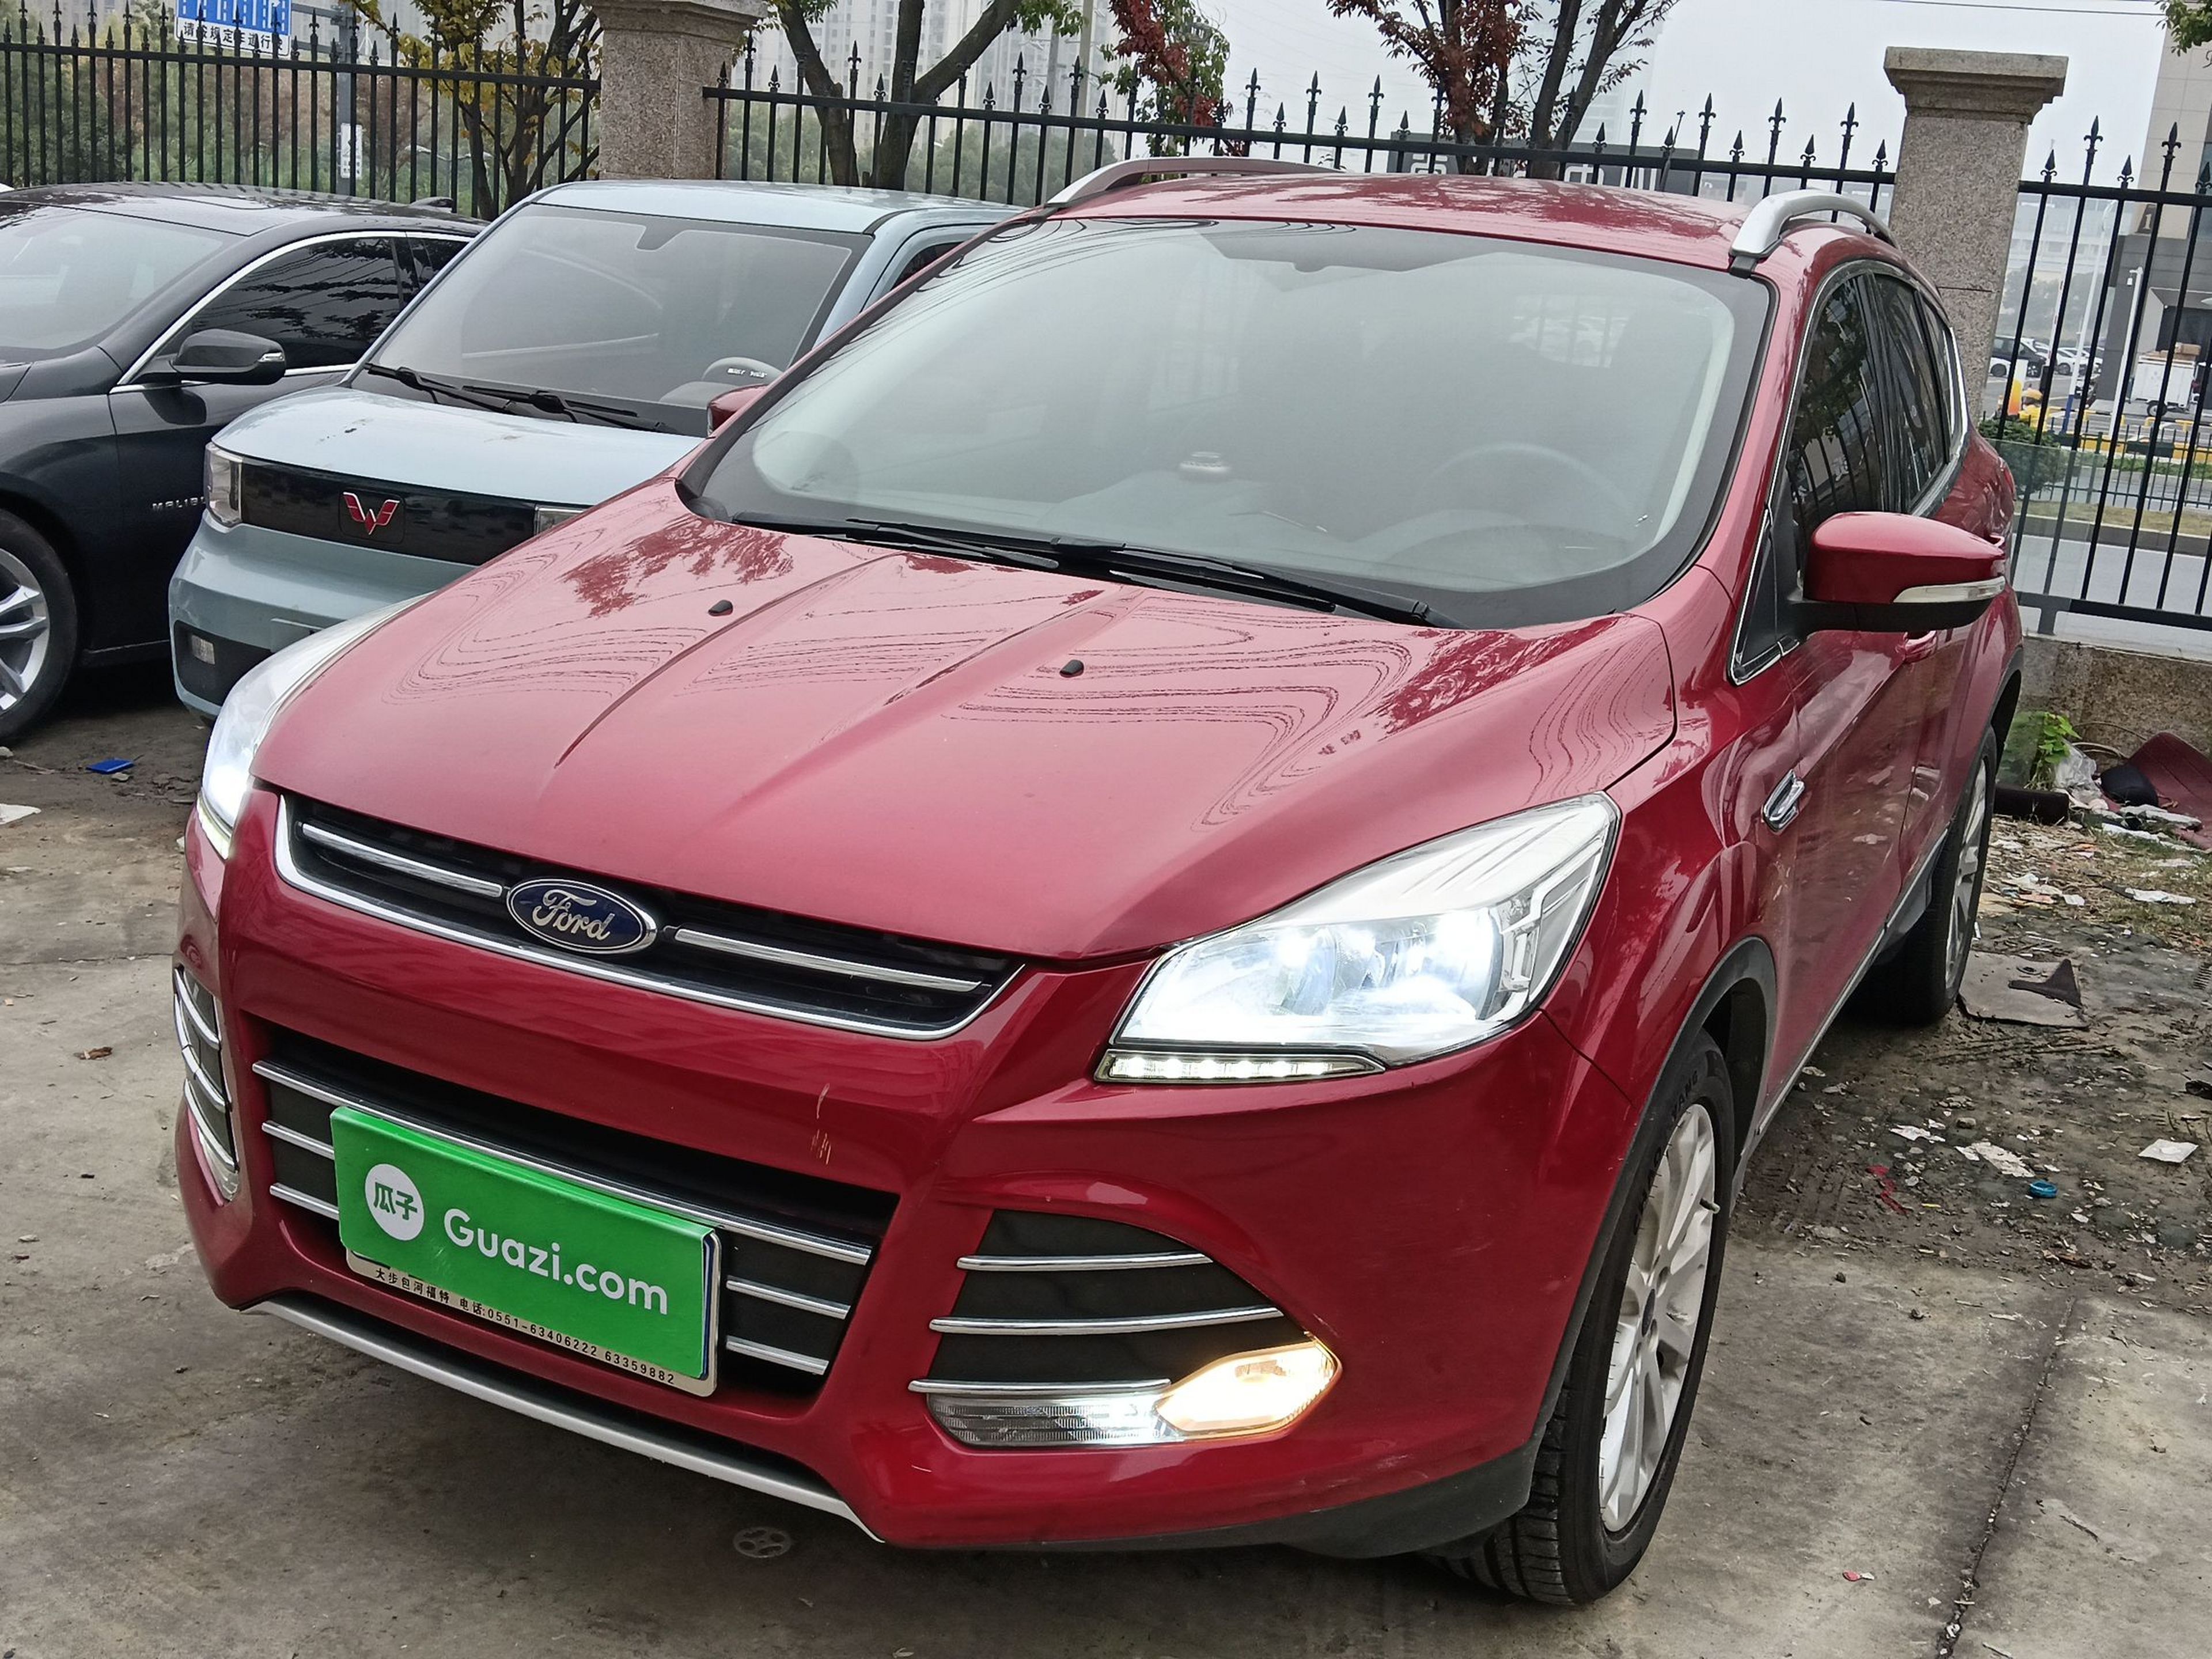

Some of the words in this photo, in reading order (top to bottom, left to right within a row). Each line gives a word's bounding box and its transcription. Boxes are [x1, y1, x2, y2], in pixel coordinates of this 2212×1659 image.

[532, 889, 615, 941] Ford
[373, 1181, 418, 1221] 瓜子
[444, 1208, 668, 1315] Guazi.com
[376, 1267, 449, 1304] 大步包河福特
[604, 1350, 675, 1385] 63359882
